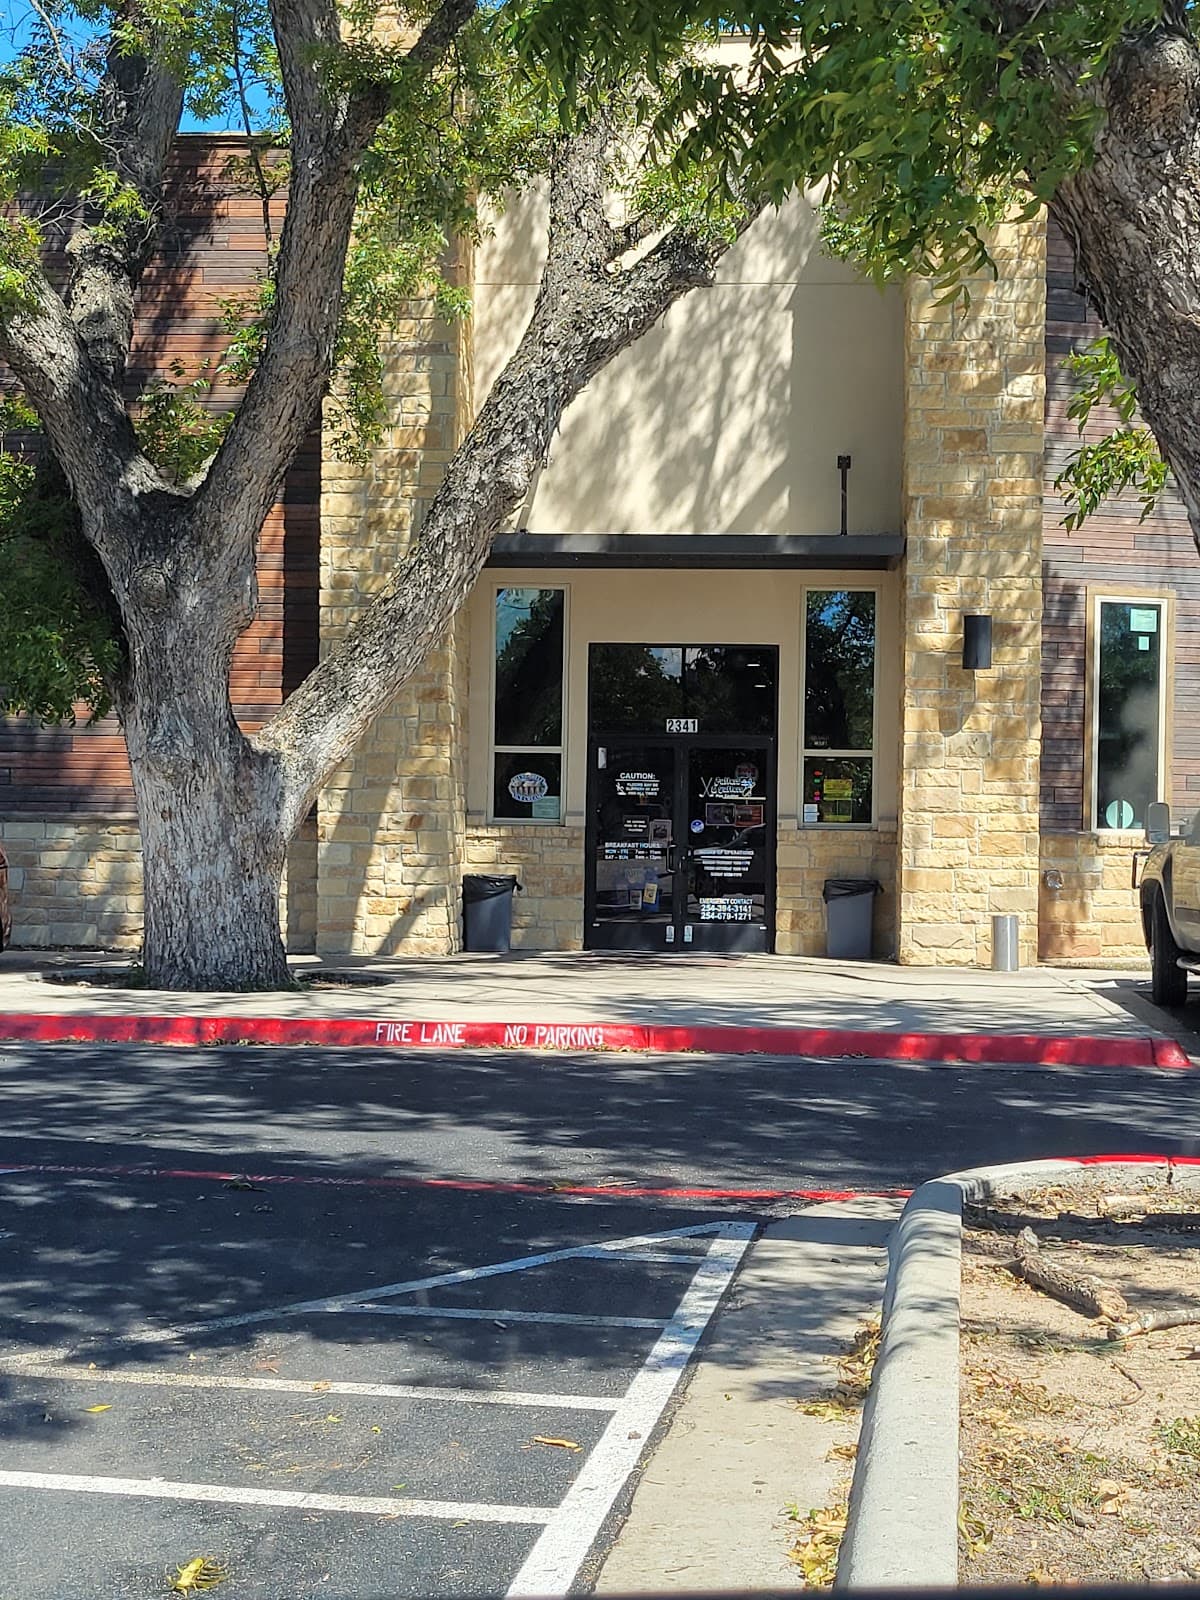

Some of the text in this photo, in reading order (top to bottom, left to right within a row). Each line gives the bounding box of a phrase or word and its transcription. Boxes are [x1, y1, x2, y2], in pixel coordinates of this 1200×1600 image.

[668, 720, 697, 732] 2341
[620, 772, 656, 780] CAUTION:
[375, 1022, 604, 1046] FIRE LANE NO PARKING
